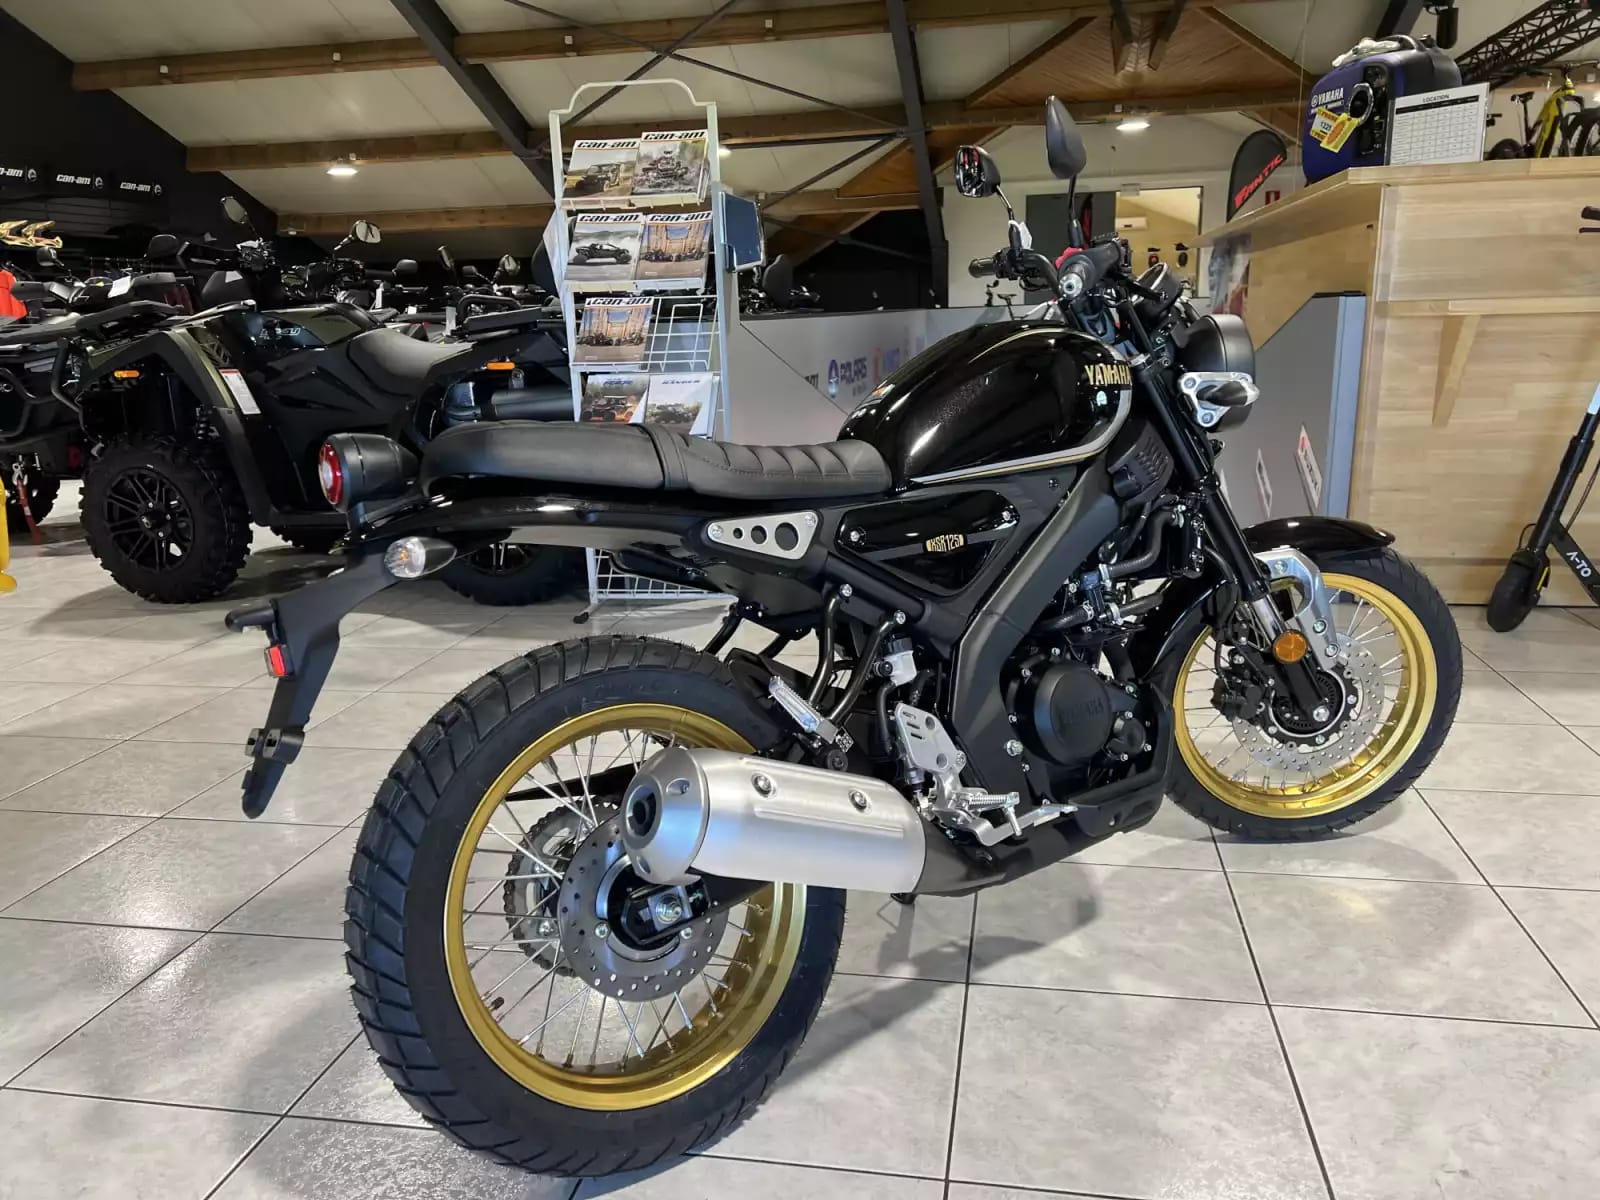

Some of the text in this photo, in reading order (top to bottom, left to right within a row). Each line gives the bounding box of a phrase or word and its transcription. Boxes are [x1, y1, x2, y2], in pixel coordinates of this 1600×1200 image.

[1318, 87, 1344, 105] YAMAHA
[643, 131, 705, 141] can-am
[577, 140, 637, 148] can-am
[0, 167, 23, 177] n-am
[56, 174, 91, 185] can-am
[120, 181, 151, 192] can-am
[579, 214, 640, 222] can-am
[649, 212, 712, 222] can-am
